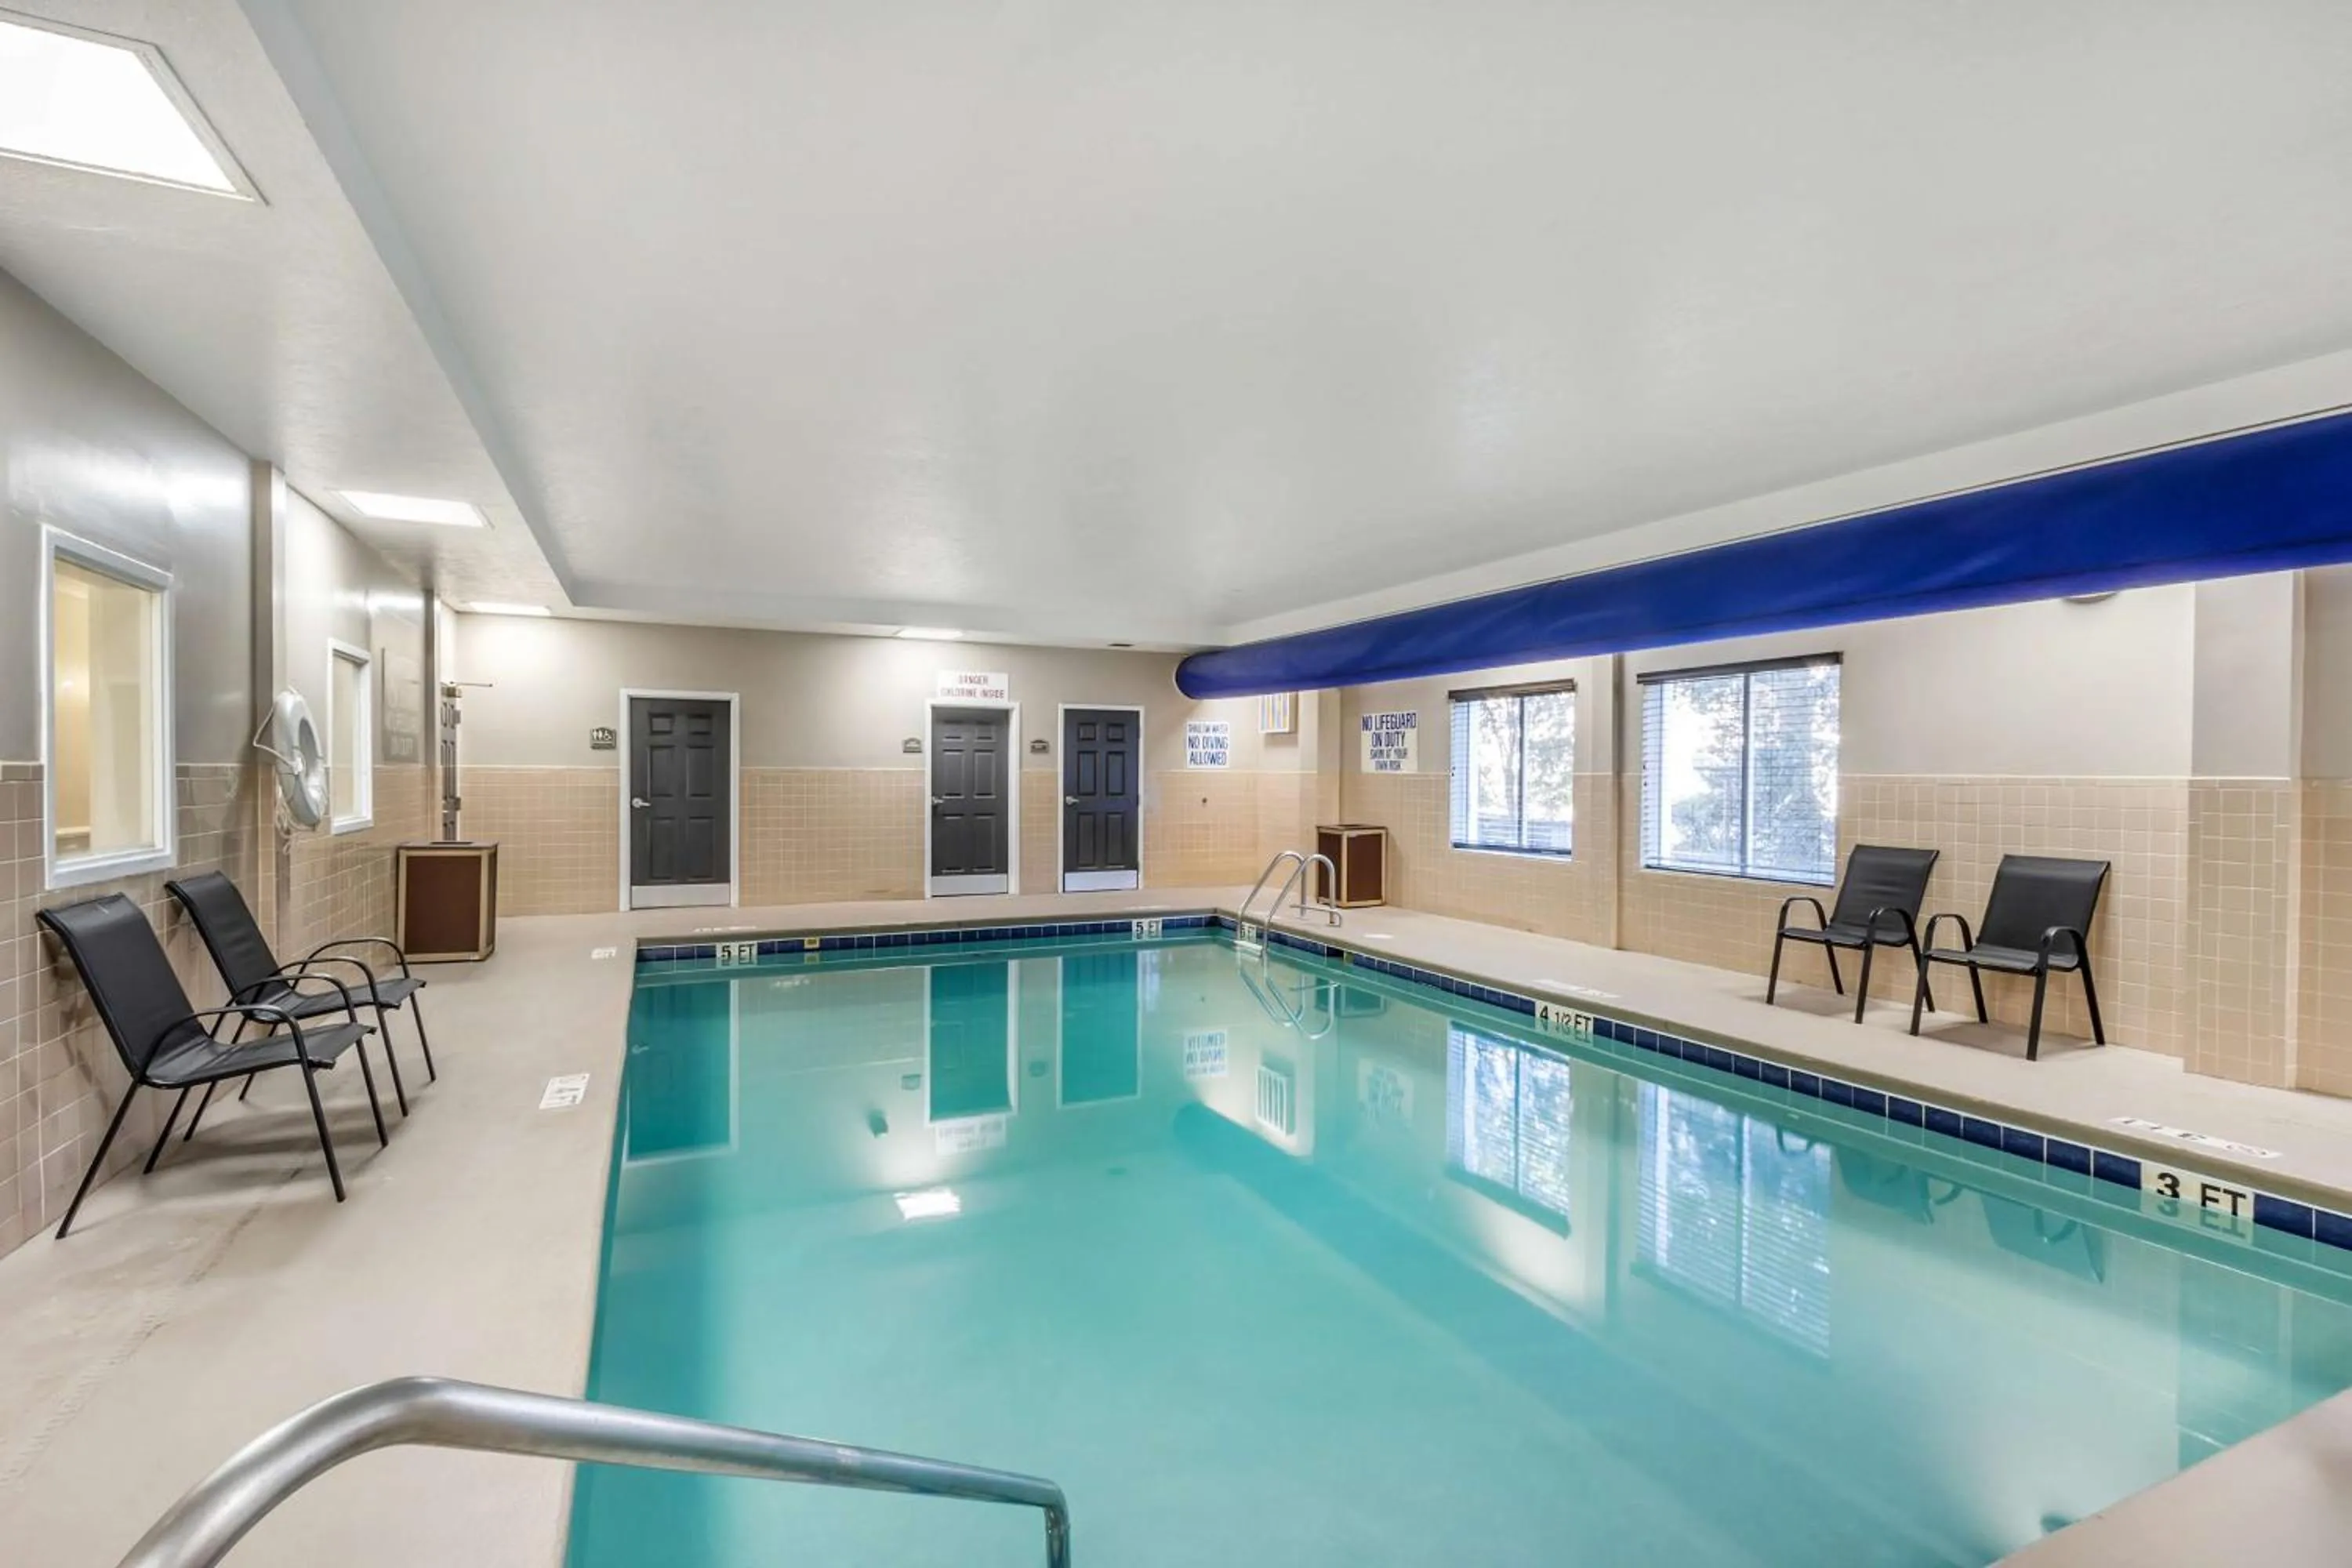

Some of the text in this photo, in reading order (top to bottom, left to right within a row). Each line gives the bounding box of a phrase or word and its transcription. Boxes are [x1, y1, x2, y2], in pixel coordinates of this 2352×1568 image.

[1362, 713, 1416, 731] NO LIFEGUARD
[1188, 735, 1229, 750] NO DIVING
[1372, 731, 1405, 747] ON DUTY
[1189, 751, 1227, 765] ALLOWED
[1136, 921, 1144, 933] 5
[721, 943, 755, 957] 5 FT
[1539, 1005, 1549, 1020] 4
[1573, 1013, 1592, 1032] FT
[2157, 1171, 2247, 1217] 3 FT
